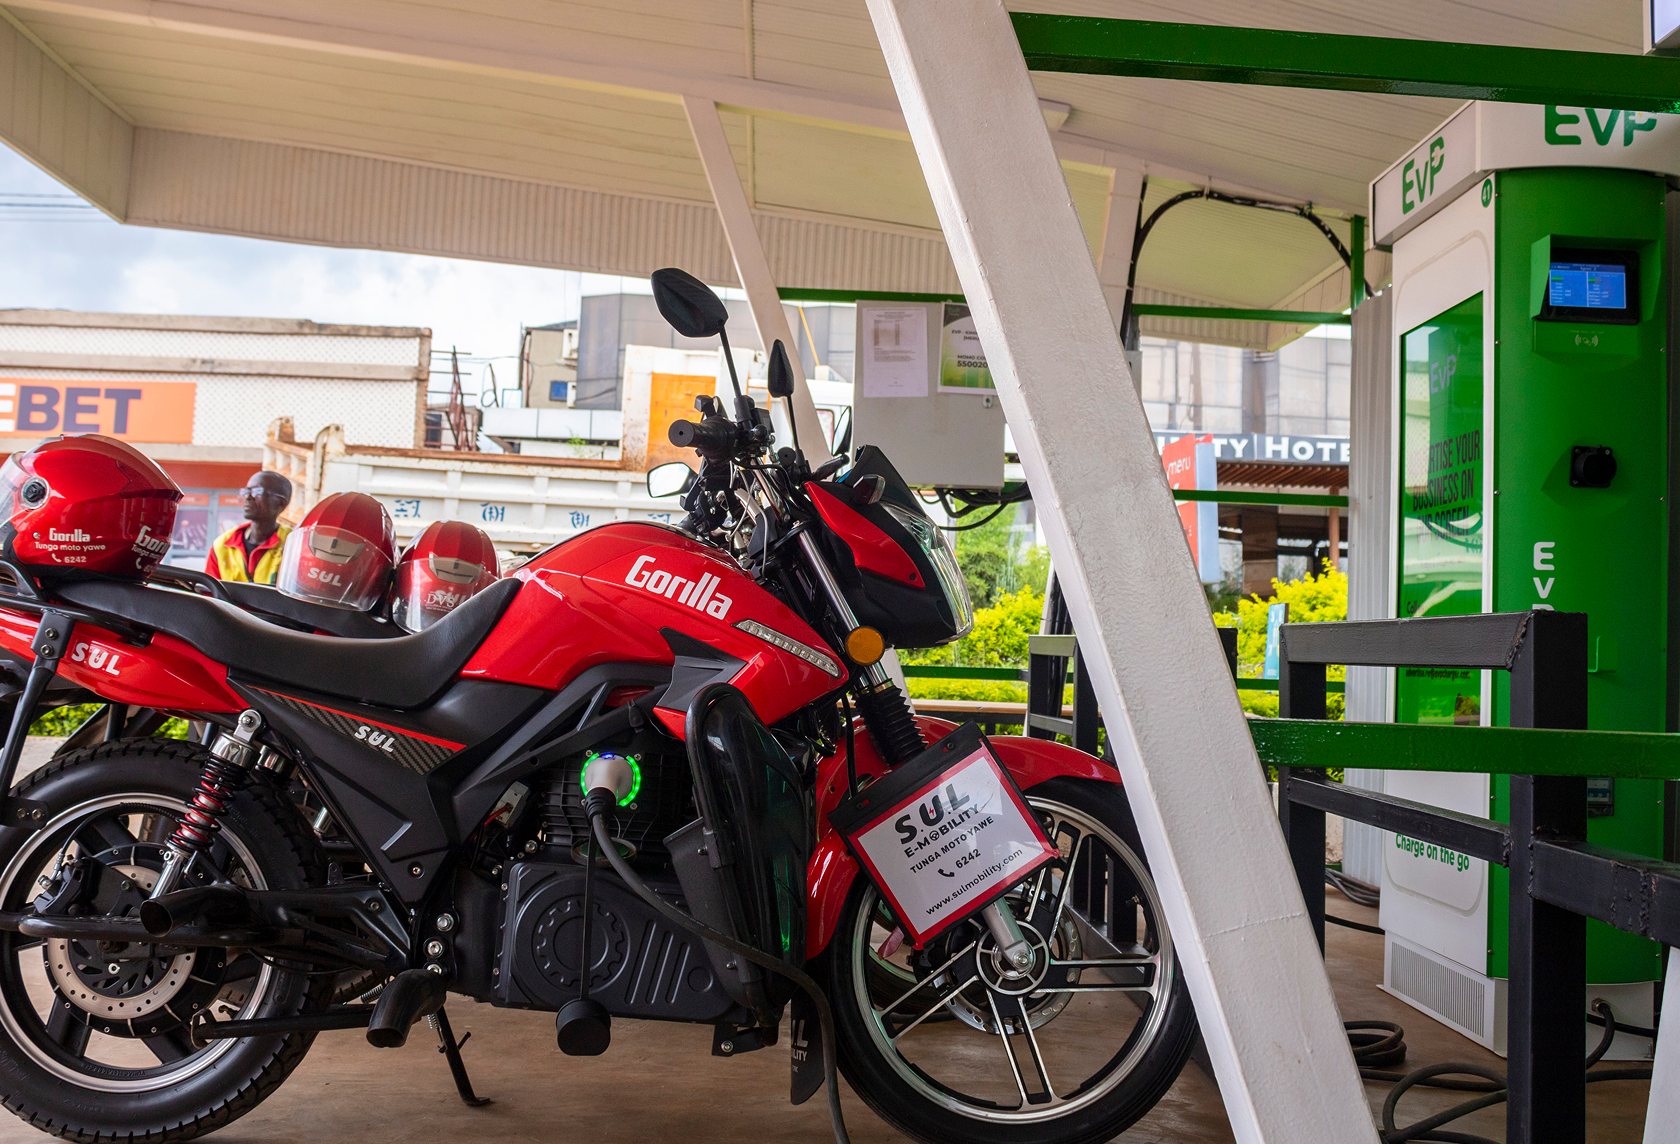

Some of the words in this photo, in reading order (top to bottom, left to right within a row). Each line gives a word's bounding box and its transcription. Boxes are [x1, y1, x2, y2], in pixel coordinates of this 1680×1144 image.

[1456, 429, 1480, 466] YOUR
[1461, 467, 1474, 500] ON
[35, 541, 58, 551] Tunga
[82, 544, 106, 552] yawe
[49, 528, 90, 542] Gorilla
[625, 555, 732, 620] Gorilla
[910, 850, 942, 874] TUNGA
[942, 833, 967, 855] MOTO
[968, 816, 994, 837] YAWE
[955, 848, 981, 869] 6242
[1396, 833, 1424, 858] Charge
[1427, 845, 1438, 860] on
[1440, 847, 1455, 866] the
[1457, 854, 1470, 872] go
[925, 849, 1023, 915] www.sulmobility.com
